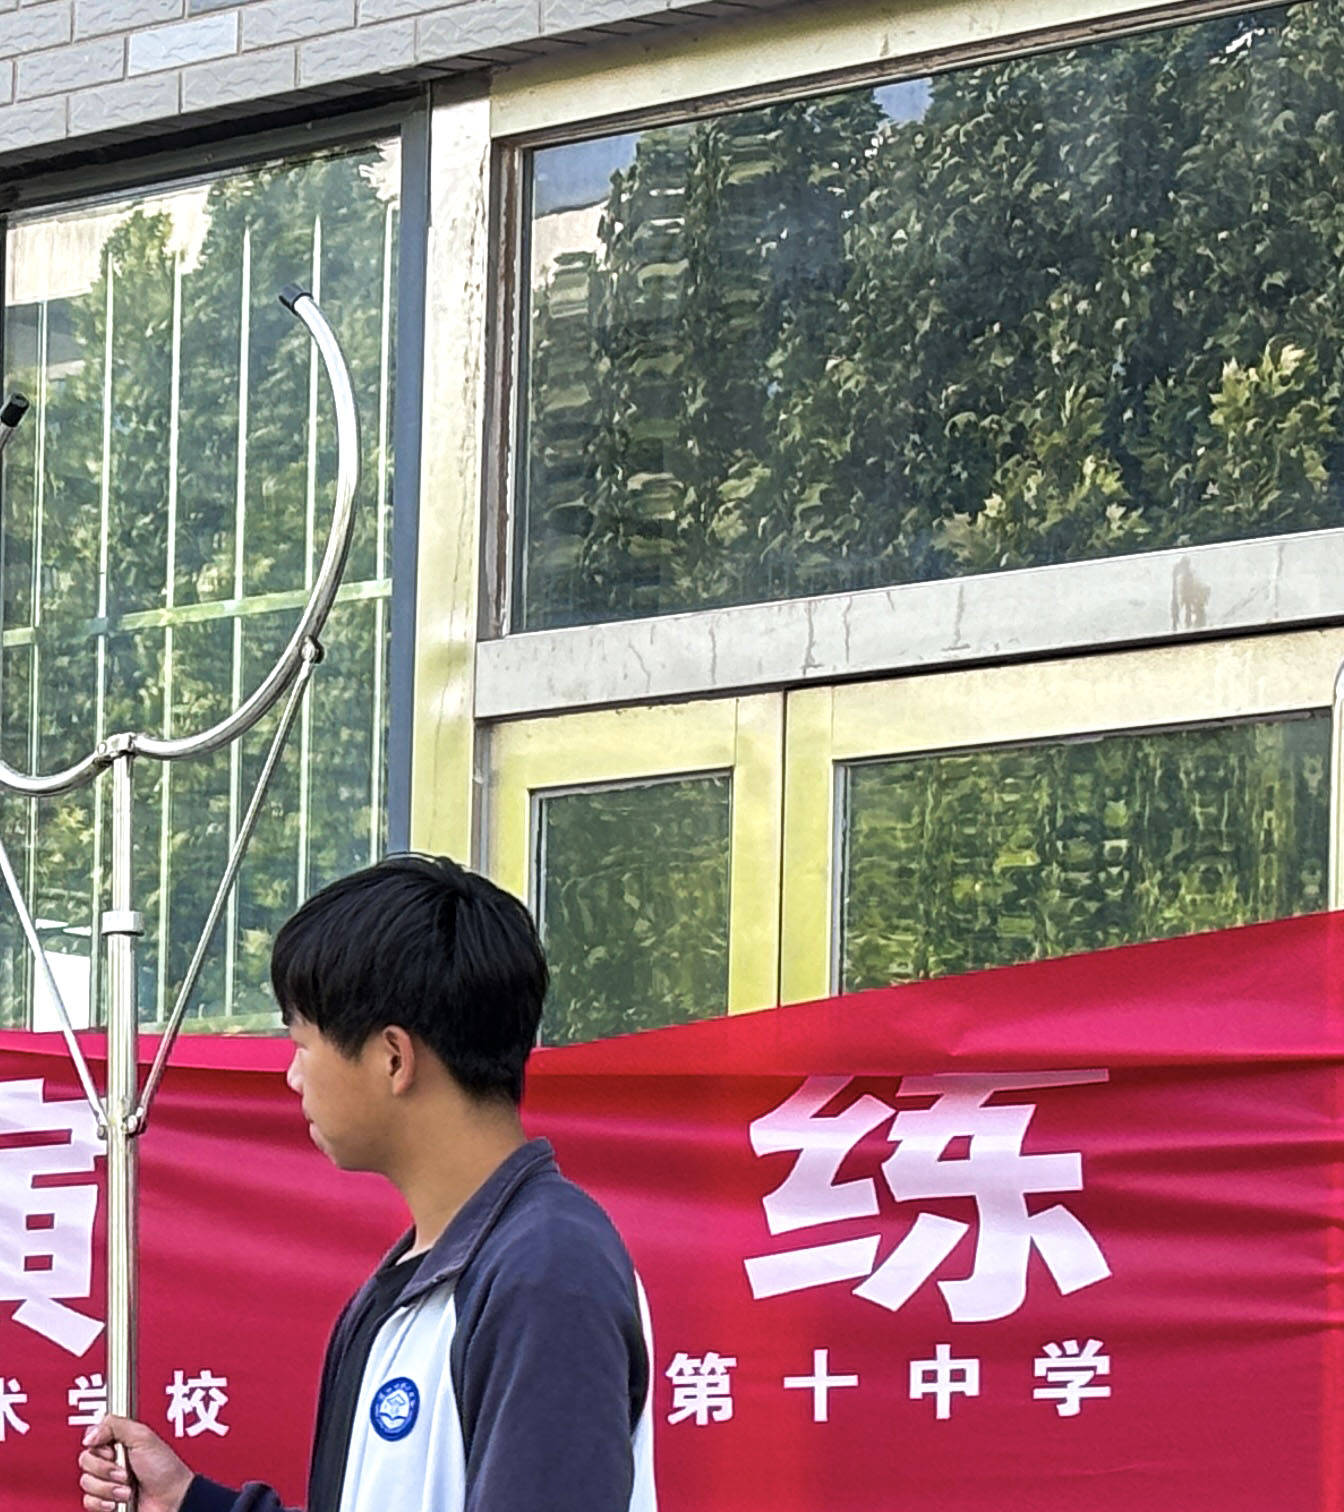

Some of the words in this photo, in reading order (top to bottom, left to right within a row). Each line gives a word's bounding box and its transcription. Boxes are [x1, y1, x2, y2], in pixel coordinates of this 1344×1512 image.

[744, 1068, 1112, 1322] 练
[664, 1338, 1112, 1426] 第十中学
